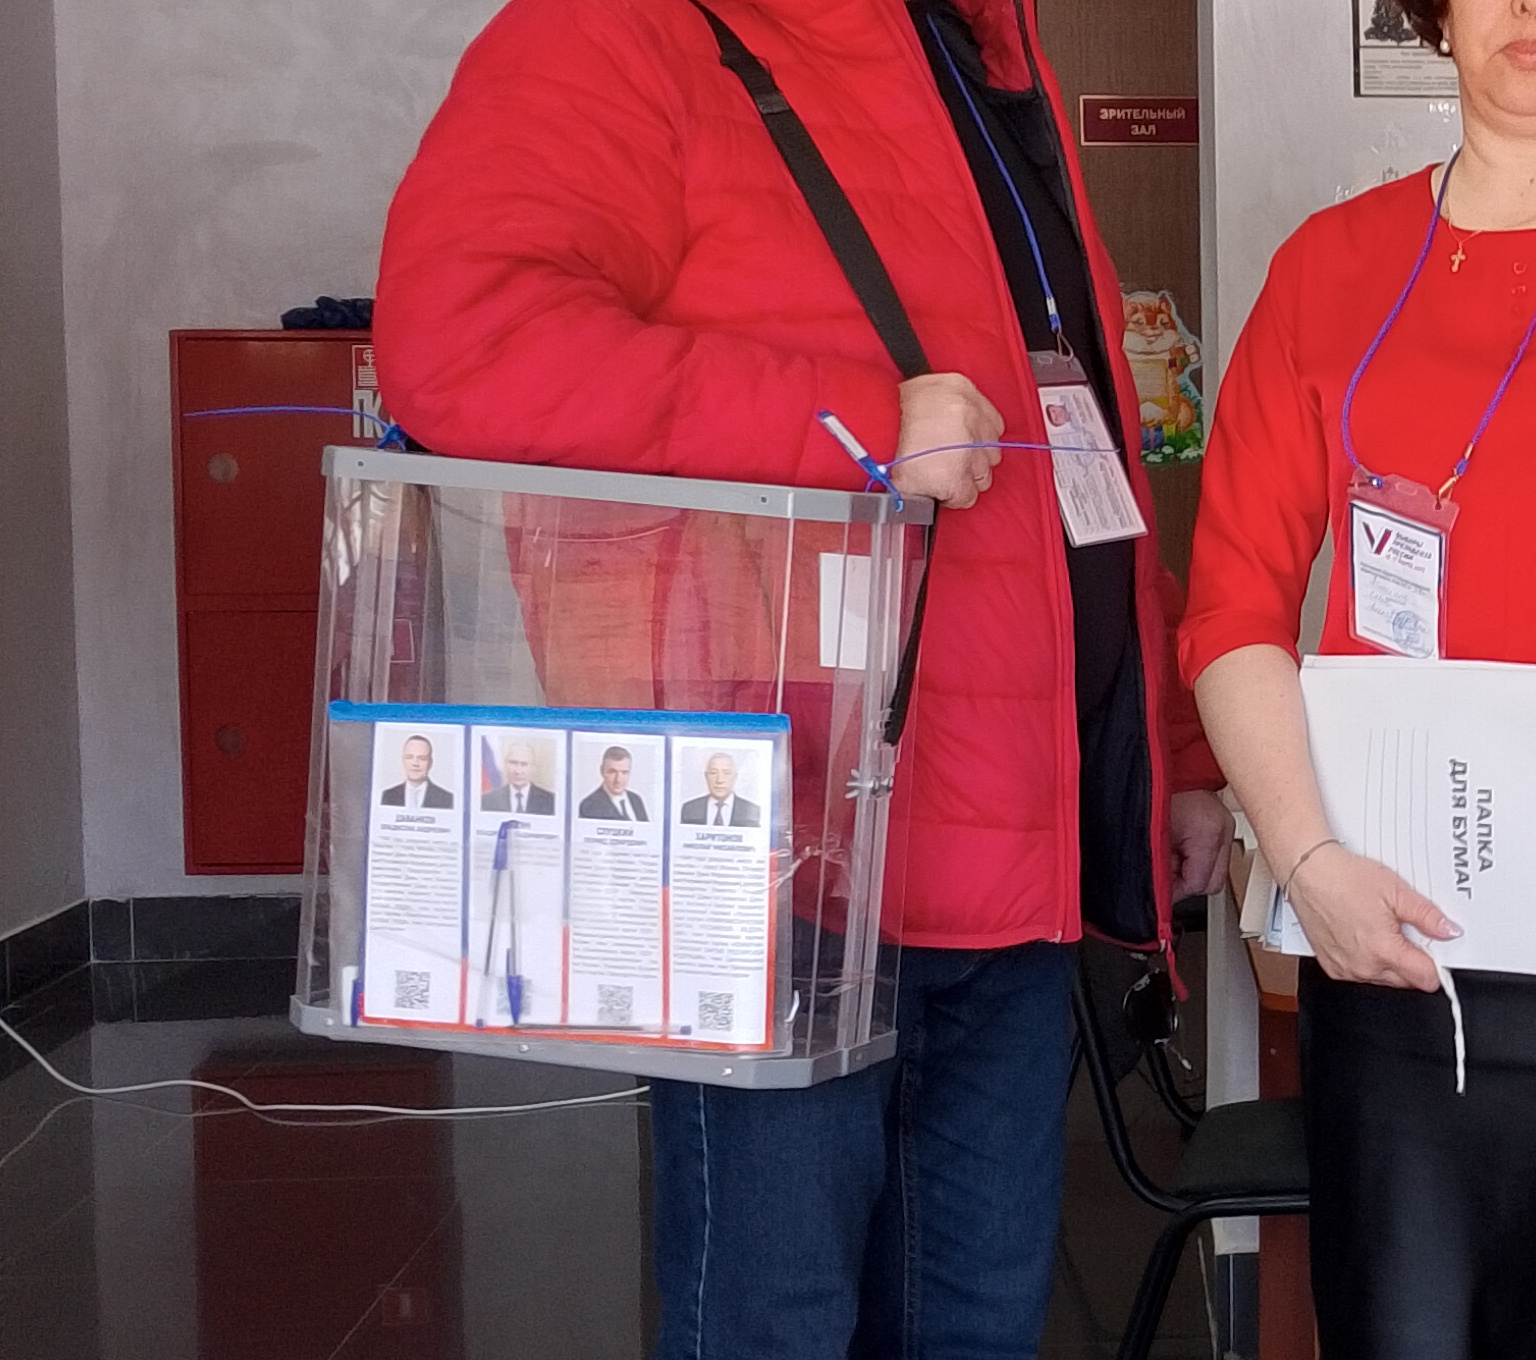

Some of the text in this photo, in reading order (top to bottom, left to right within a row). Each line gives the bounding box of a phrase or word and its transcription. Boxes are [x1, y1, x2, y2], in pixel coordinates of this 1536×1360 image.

[1099, 106, 1186, 120] ЗРИТЕЛЬНЫЙ
[1130, 124, 1157, 136] ЗАЛ
[1449, 758, 1472, 900] ДЛЯ БУМАГ
[1476, 788, 1494, 873] ПАПКА
